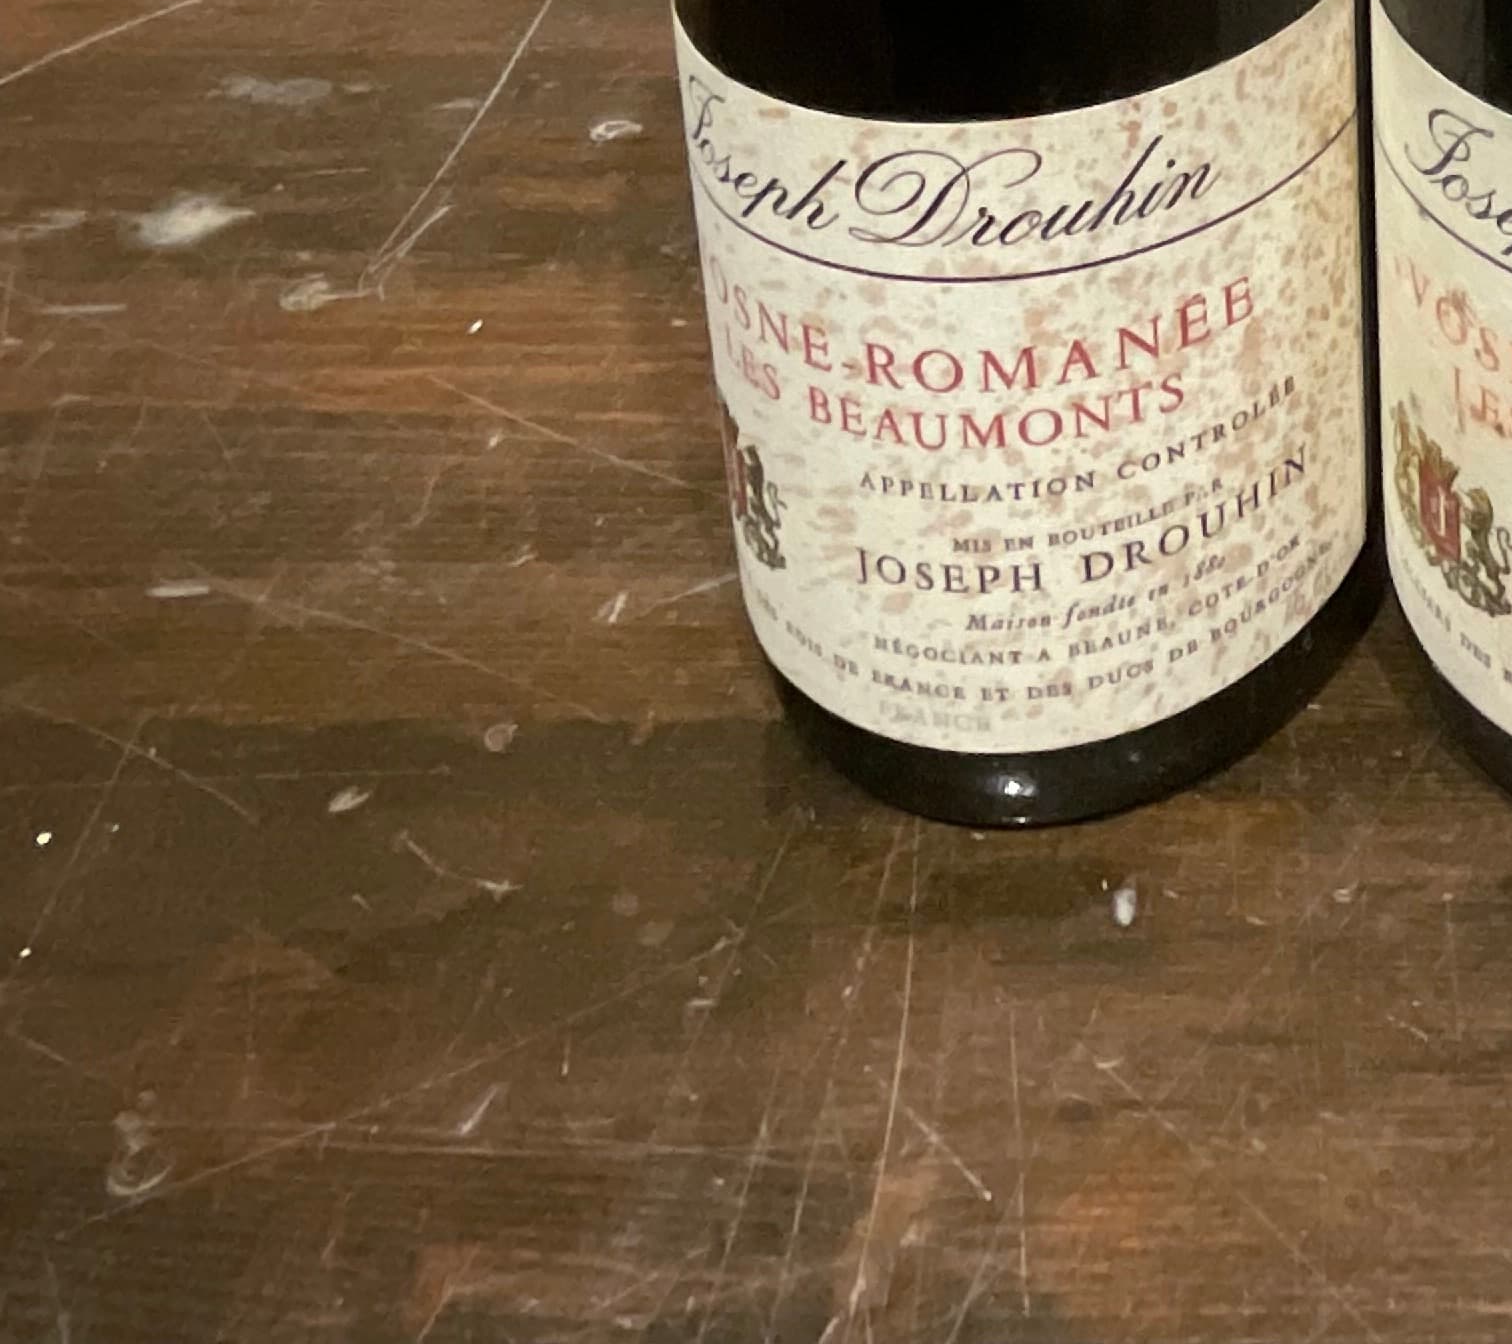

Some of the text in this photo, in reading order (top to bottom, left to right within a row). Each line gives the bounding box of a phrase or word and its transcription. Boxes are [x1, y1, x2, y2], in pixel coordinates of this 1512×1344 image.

[687, 73, 1222, 248] Joseph Drouhin
[709, 256, 1256, 394] OSNE-ROMANÉE
[809, 373, 1186, 452] BEAUMONTS
[855, 446, 1311, 594] JOSEPH DROUHIN
[859, 469, 1096, 504] APPELLATION
[952, 537, 993, 553] MIS
[1003, 536, 1034, 552] EN
[1048, 499, 1175, 547] BOUTEILLE
[966, 612, 1050, 631] Maison
[871, 669, 968, 700] FRANCE
[981, 687, 1010, 703] ET
[1026, 682, 1073, 701] DES
[1168, 638, 1199, 662] DE
